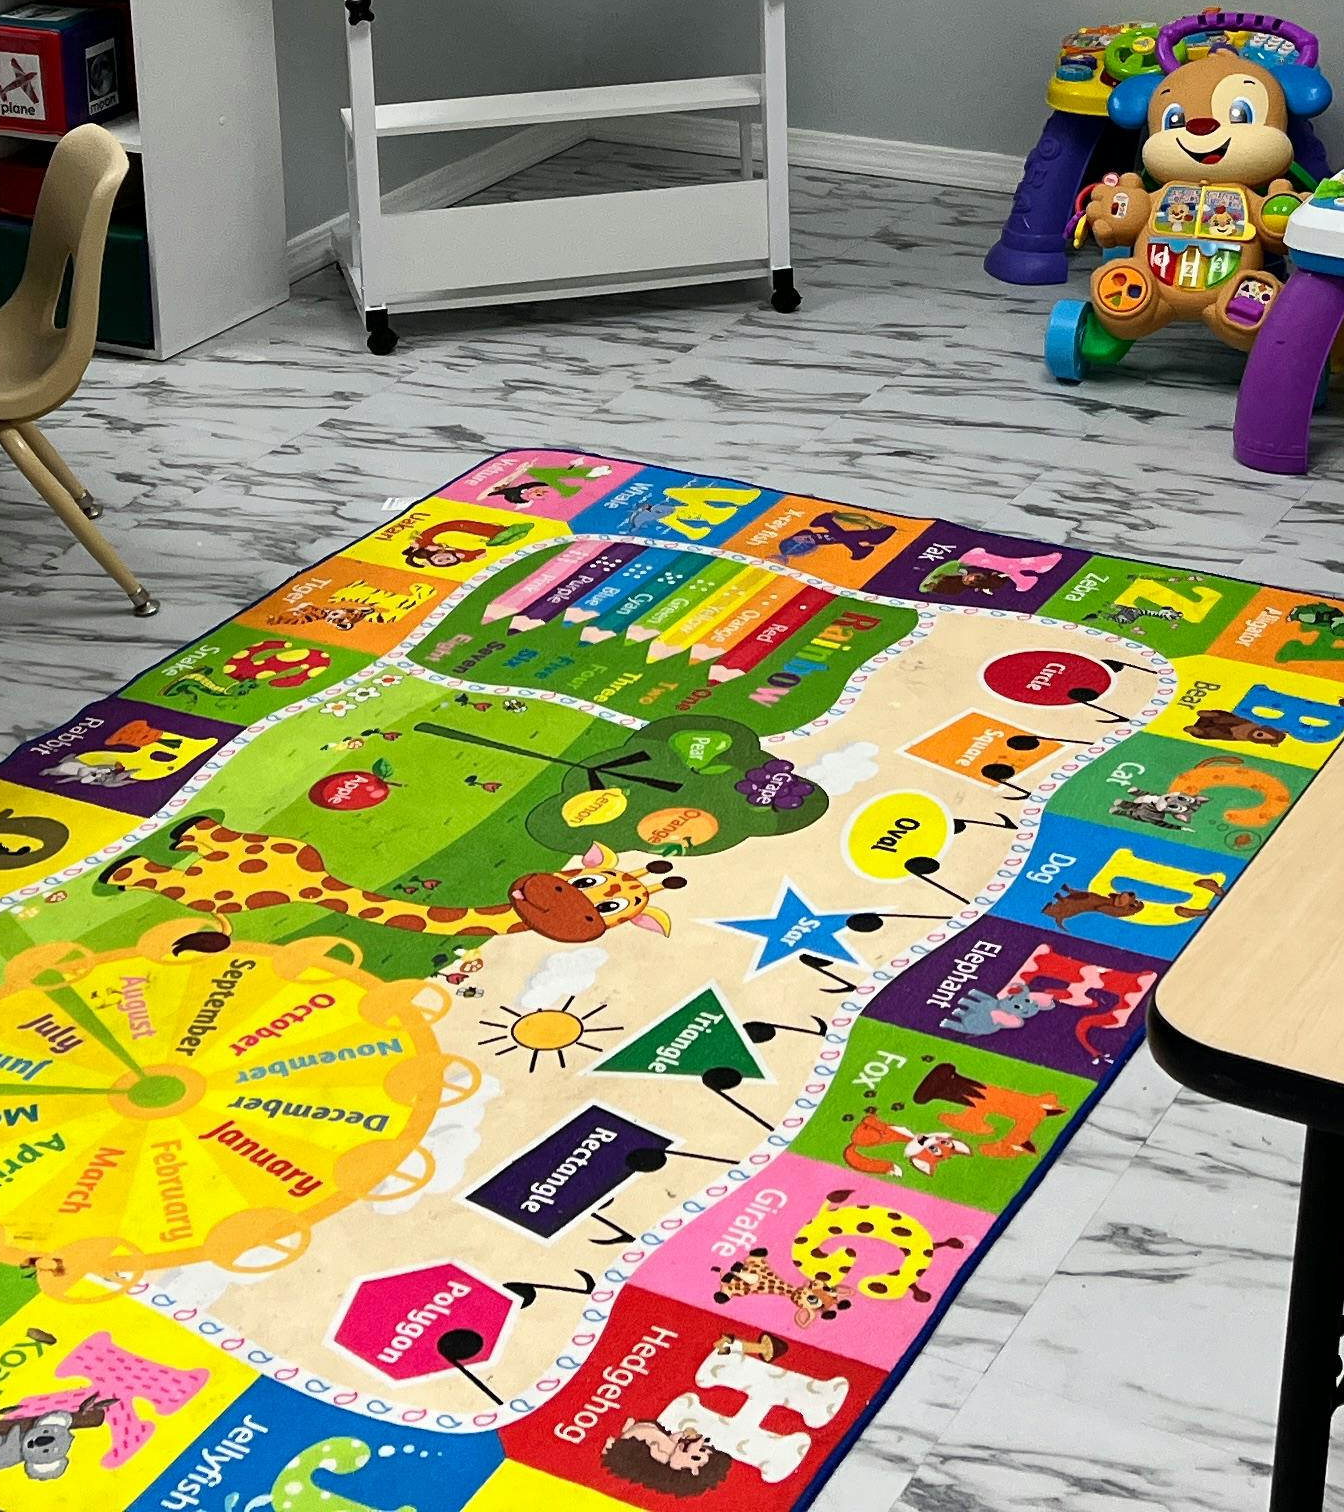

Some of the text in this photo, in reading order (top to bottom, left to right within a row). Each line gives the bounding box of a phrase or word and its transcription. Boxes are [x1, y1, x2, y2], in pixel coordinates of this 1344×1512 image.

[0, 101, 36, 116] plane
[90, 94, 117, 114] moon
[464, 457, 520, 486] Vulture
[604, 482, 654, 510] Whale
[659, 487, 762, 540] W
[808, 511, 897, 561] X
[918, 541, 957, 563] Yak
[282, 577, 333, 605] Tiger
[546, 575, 595, 605] Purple
[584, 586, 621, 607] Blue
[616, 593, 654, 615] Cyan
[1064, 572, 1111, 604] Zebra
[1114, 575, 1224, 624] Z
[647, 598, 690, 625] Green
[682, 604, 724, 636] Yellow
[711, 609, 762, 644] Orange
[1234, 606, 1284, 650] Alligator
[756, 623, 789, 644] Red
[160, 644, 221, 677] Snake
[223, 640, 332, 688] S
[452, 640, 507, 675] Seven
[534, 654, 575, 681] Five
[748, 610, 883, 708] Rainbow
[567, 664, 608, 690] Four
[593, 672, 644, 703] Three
[639, 681, 680, 706] Two
[1025, 660, 1068, 693] Circle
[675, 688, 713, 712] One
[1178, 680, 1222, 712] Bear
[29, 714, 105, 757] Rabbit
[689, 737, 711, 762] Pear
[954, 727, 1006, 769] Square
[327, 773, 369, 807] Apple
[756, 772, 792, 805] Grape
[1105, 760, 1146, 785] Cat
[569, 792, 620, 824] Lemon
[1168, 762, 1292, 826] C
[647, 809, 702, 844] Orange
[870, 816, 921, 854] Oval
[1025, 852, 1077, 886] Dog
[1087, 848, 1228, 928] D
[780, 915, 822, 948] Star
[926, 939, 1004, 1009] Elephant
[118, 975, 157, 1041] August
[176, 956, 258, 1058] September
[228, 991, 337, 1058] October
[17, 1011, 85, 1056] July
[647, 1011, 724, 1073] Triangle
[235, 1036, 404, 1084] November
[852, 1049, 909, 1091] Fox
[227, 1092, 391, 1133] December
[198, 1119, 325, 1199] January
[517, 1124, 620, 1216] Rectangle
[57, 1146, 127, 1215] March
[150, 1138, 194, 1245] February
[710, 1187, 790, 1259] Giraffe
[375, 1279, 473, 1366] Polygon
[552, 1324, 679, 1446] Hedgehog
[657, 1340, 851, 1485] H
[160, 1414, 270, 1510] Jellyfish
